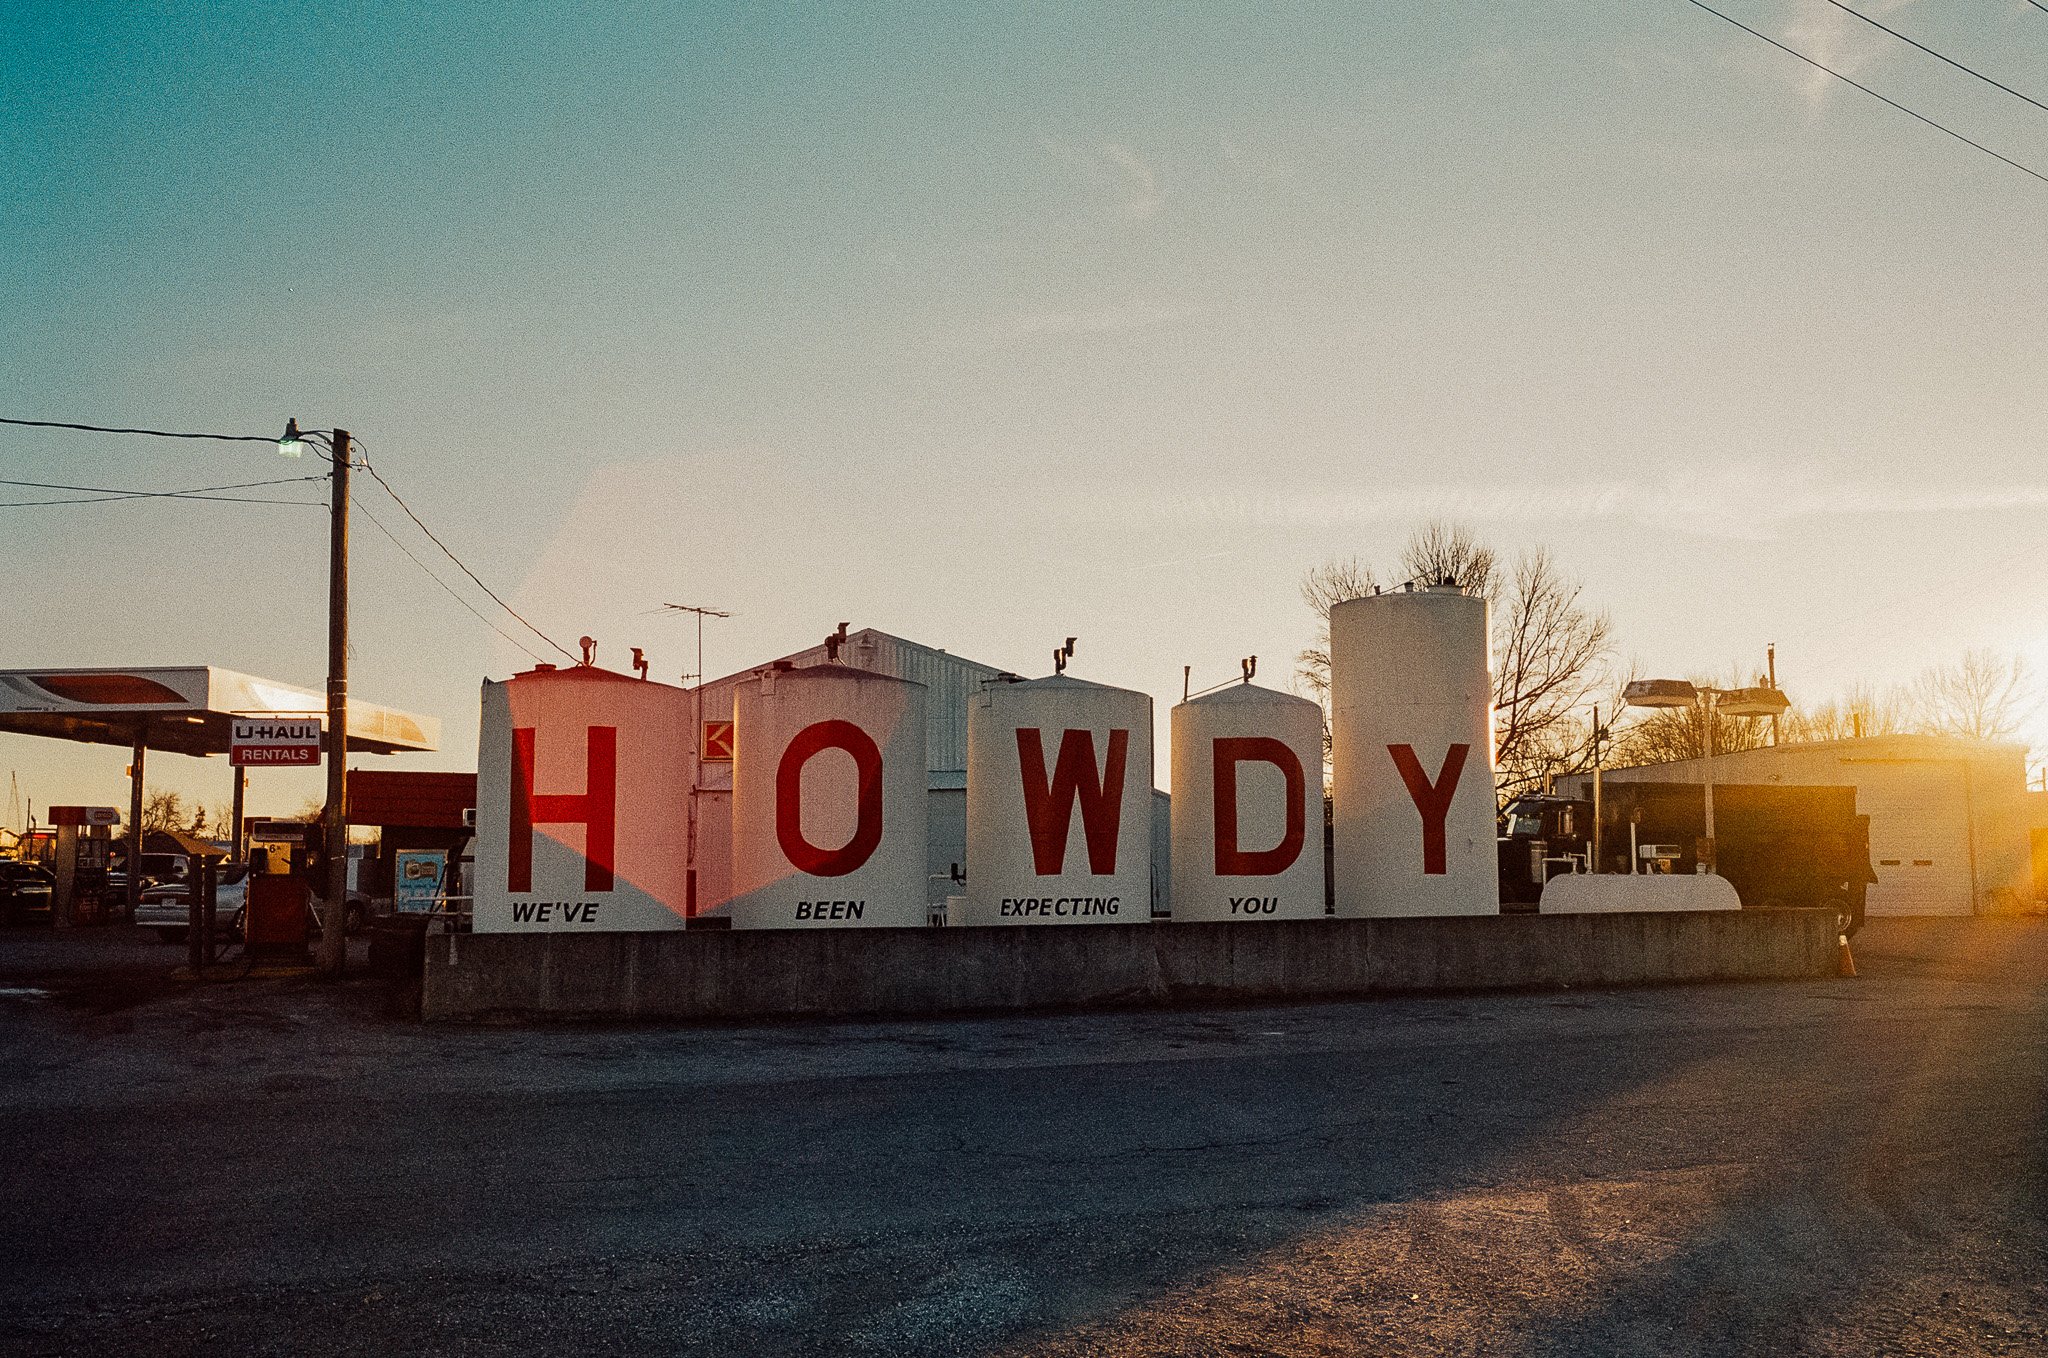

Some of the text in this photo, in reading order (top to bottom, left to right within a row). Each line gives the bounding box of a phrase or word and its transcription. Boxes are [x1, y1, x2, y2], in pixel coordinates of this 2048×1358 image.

[235, 726, 317, 739] U-HAUL
[242, 749, 309, 760] RENTALS
[508, 719, 1470, 892] HOWDY
[512, 896, 1278, 923] WE'VE BEEN EXPECTING YOU
